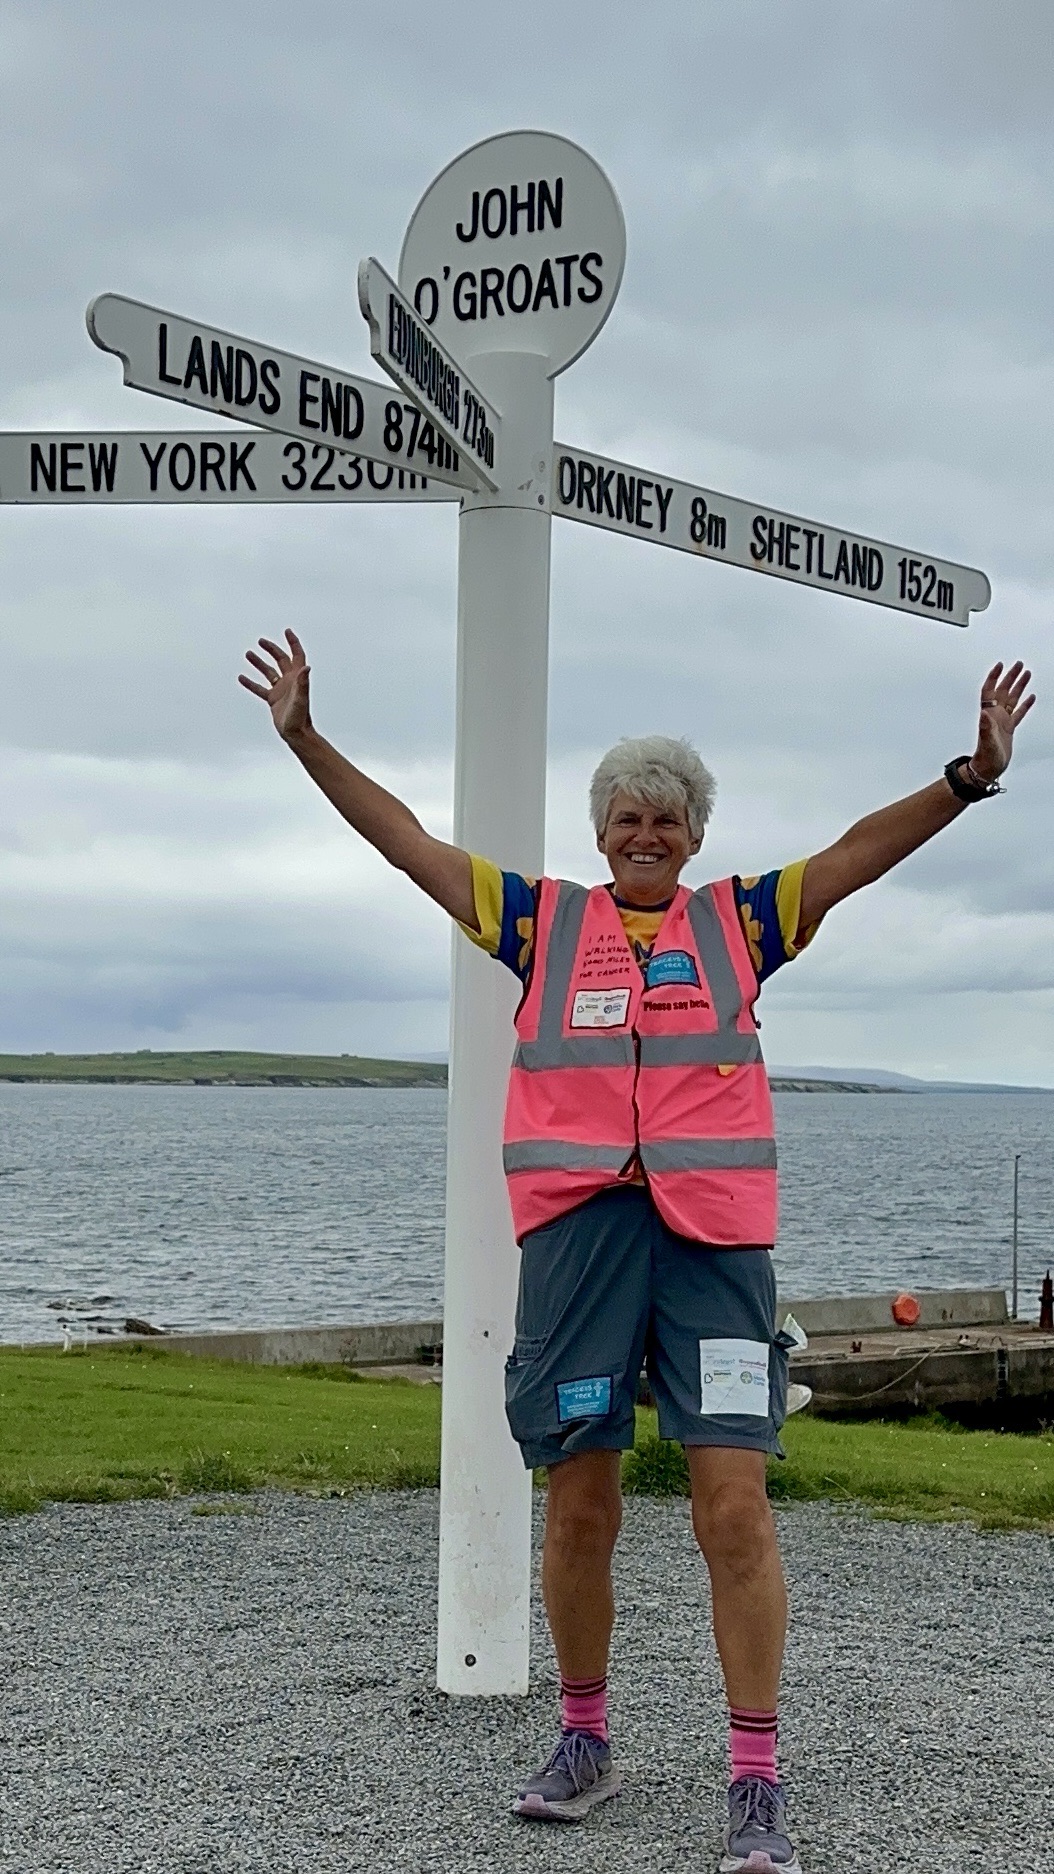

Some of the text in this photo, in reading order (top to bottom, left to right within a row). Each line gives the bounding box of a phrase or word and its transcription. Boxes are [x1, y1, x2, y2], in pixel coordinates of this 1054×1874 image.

[456, 177, 563, 242] JOHN
[414, 252, 603, 325] O'GROATS
[158, 323, 281, 415] LANDS
[299, 371, 365, 440] END
[388, 293, 495, 469] EDINBURGH 273m
[30, 443, 118, 492] NEW
[140, 442, 257, 492] YORK
[558, 456, 955, 612] ORKNEY 8m SHETLAND 152m
[579, 967, 630, 979] FOR CANCER
[585, 946, 629, 957] WALKING
[643, 1001, 672, 1011] Please
[672, 1001, 688, 1010] say
